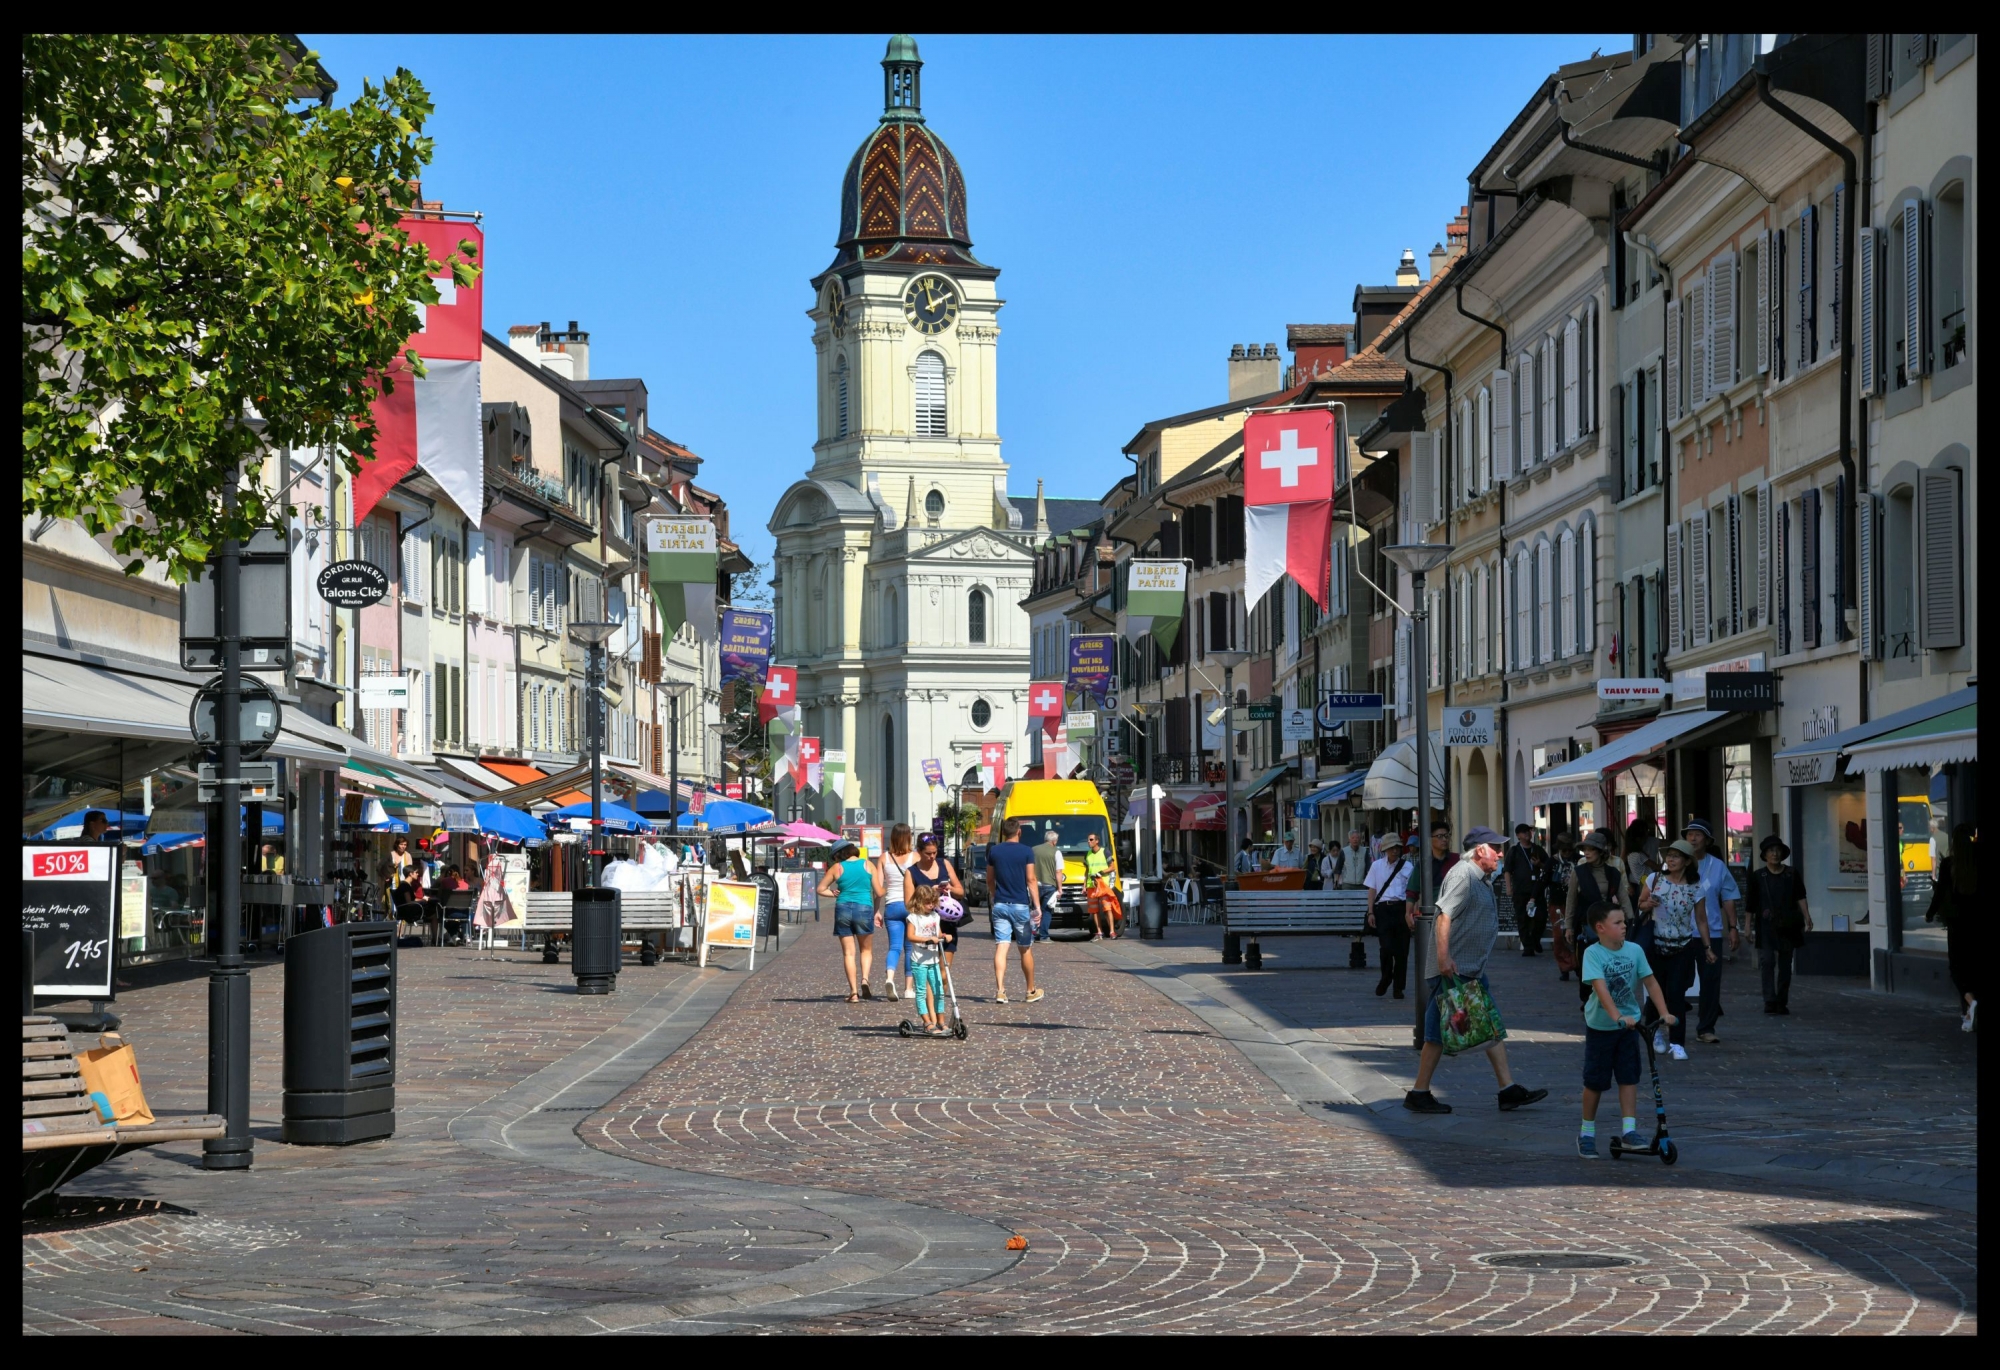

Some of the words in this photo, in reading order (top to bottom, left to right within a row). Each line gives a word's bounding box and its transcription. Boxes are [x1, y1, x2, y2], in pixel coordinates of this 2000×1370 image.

[320, 563, 385, 585] CORDONNERIE
[1136, 565, 1180, 575] LIBERTÉ
[1138, 579, 1176, 588] PATRIE
[1710, 684, 1771, 698] minelli
[1333, 696, 1365, 704] KAUF
[1448, 727, 1487, 735] FONTANA
[1449, 735, 1488, 743] AVOCATS
[1788, 757, 1821, 784] Baskets&Co
[38, 854, 85, 874] -50%
